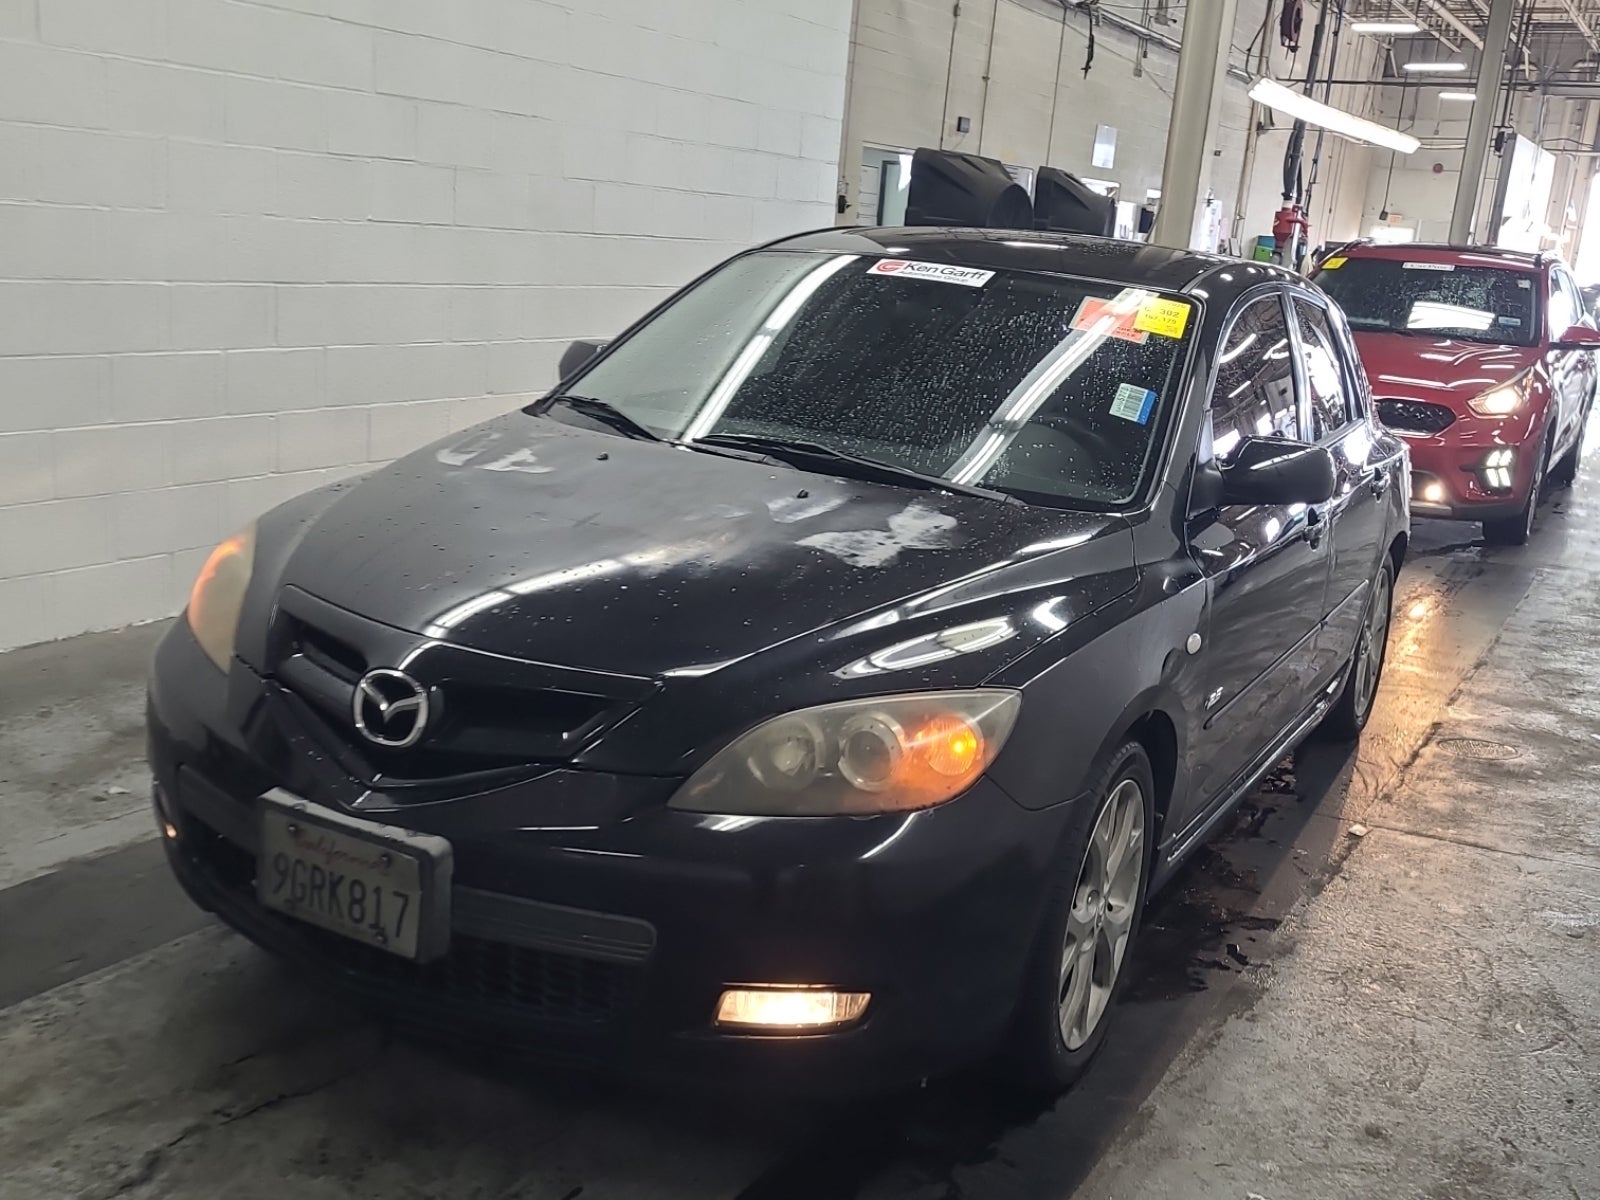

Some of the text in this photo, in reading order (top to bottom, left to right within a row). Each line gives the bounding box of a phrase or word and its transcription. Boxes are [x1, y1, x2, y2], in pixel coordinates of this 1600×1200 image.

[902, 262, 986, 280] Ken Garff
[271, 851, 410, 939] 9GRK817
